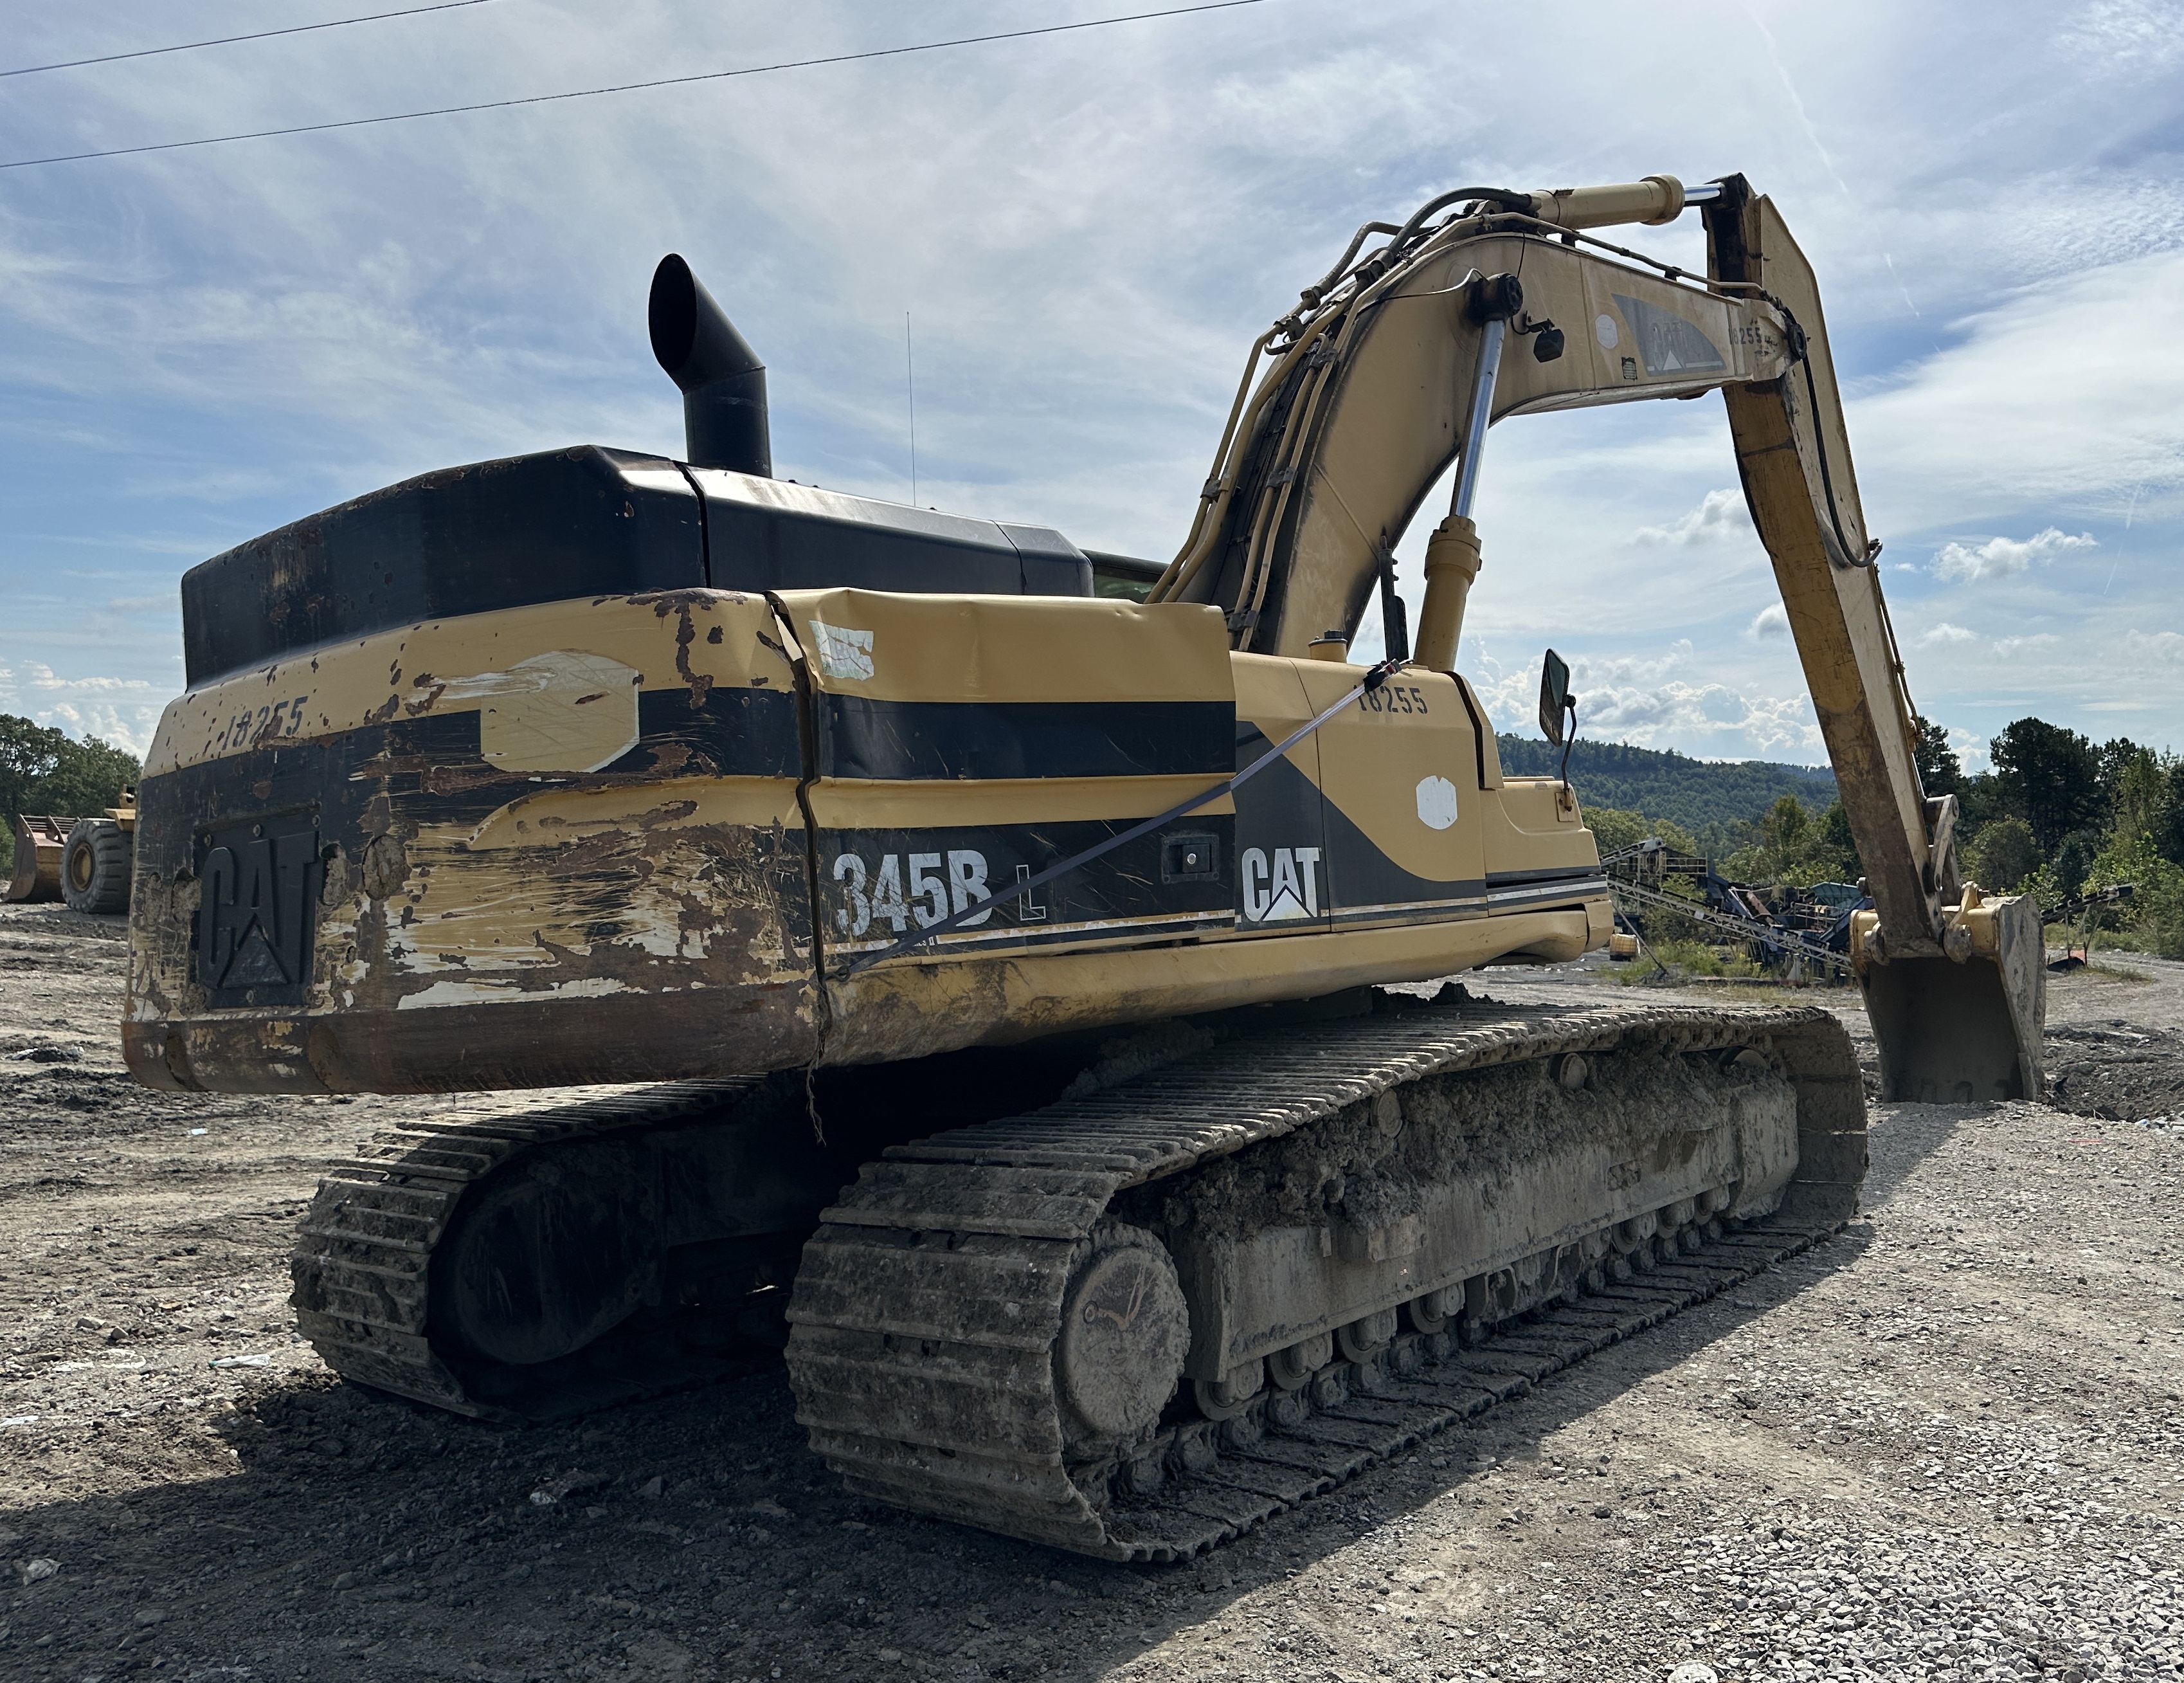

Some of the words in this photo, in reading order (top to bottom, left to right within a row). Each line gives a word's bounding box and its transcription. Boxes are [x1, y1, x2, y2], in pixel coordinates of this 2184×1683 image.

[221, 696, 309, 751] 18255
[1353, 685, 1428, 714] 18255
[199, 832, 320, 989] CAT
[833, 850, 993, 936] 345B
[1016, 864, 1046, 921] L
[1241, 847, 1320, 922] CAT
